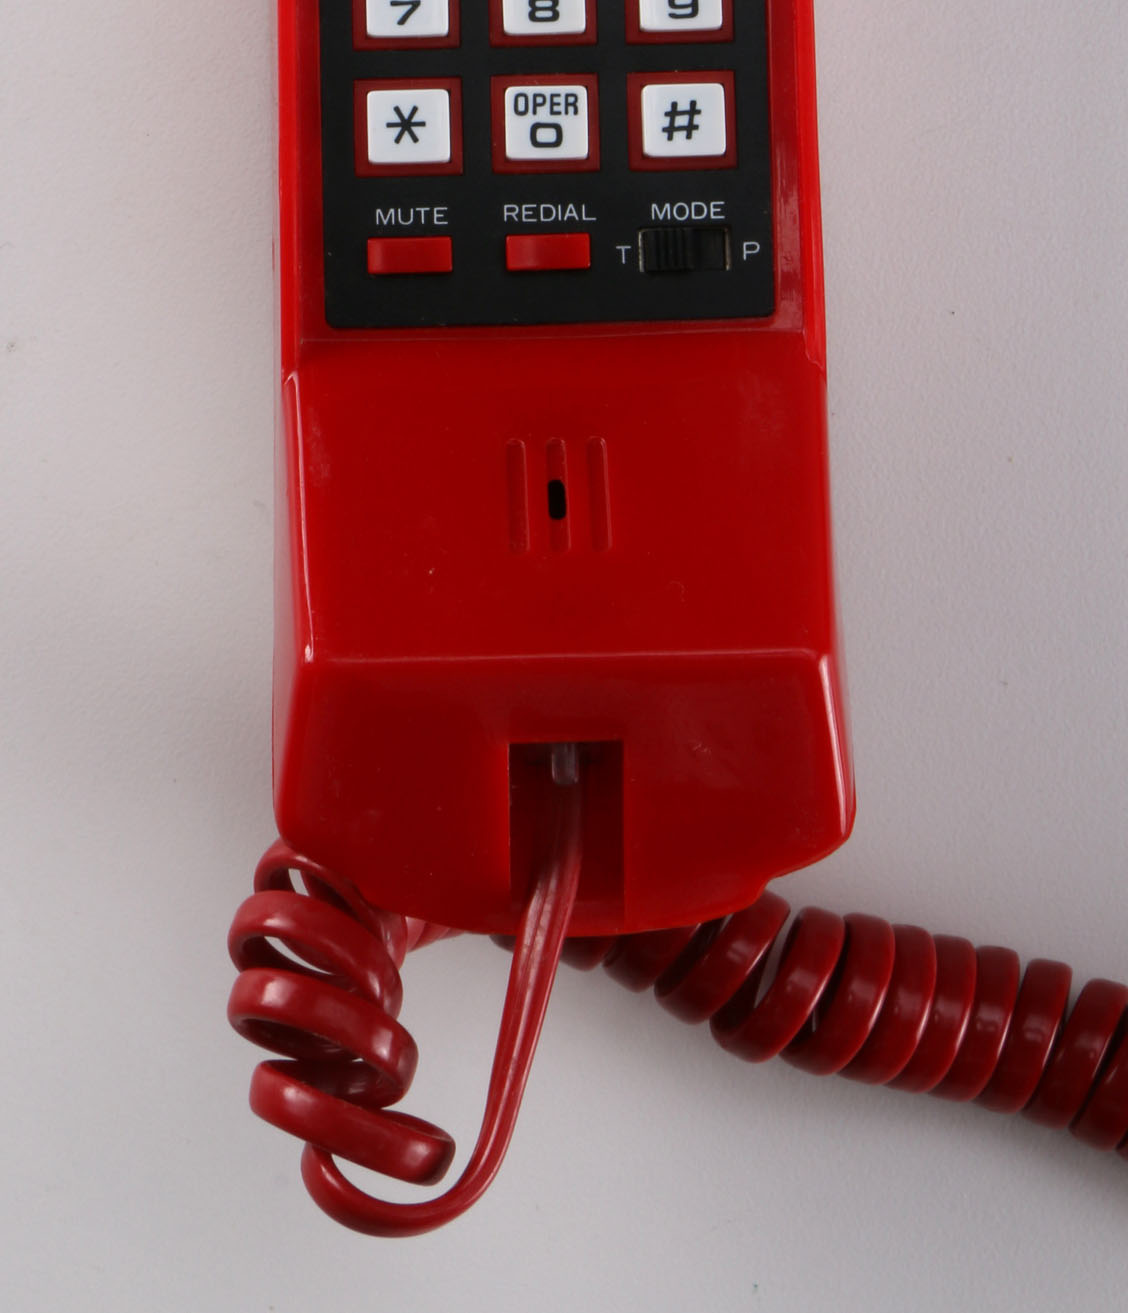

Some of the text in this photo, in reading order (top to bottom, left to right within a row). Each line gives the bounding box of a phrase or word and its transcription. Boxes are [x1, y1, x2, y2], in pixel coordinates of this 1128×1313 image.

[390, 0, 421, 25] 7
[514, 93, 578, 116] OPER
[530, 122, 563, 148] 0
[376, 207, 448, 225] MUTE
[504, 204, 596, 222] REDIAL
[652, 201, 725, 220] MODE
[616, 245, 631, 264] T
[743, 242, 760, 260] P
